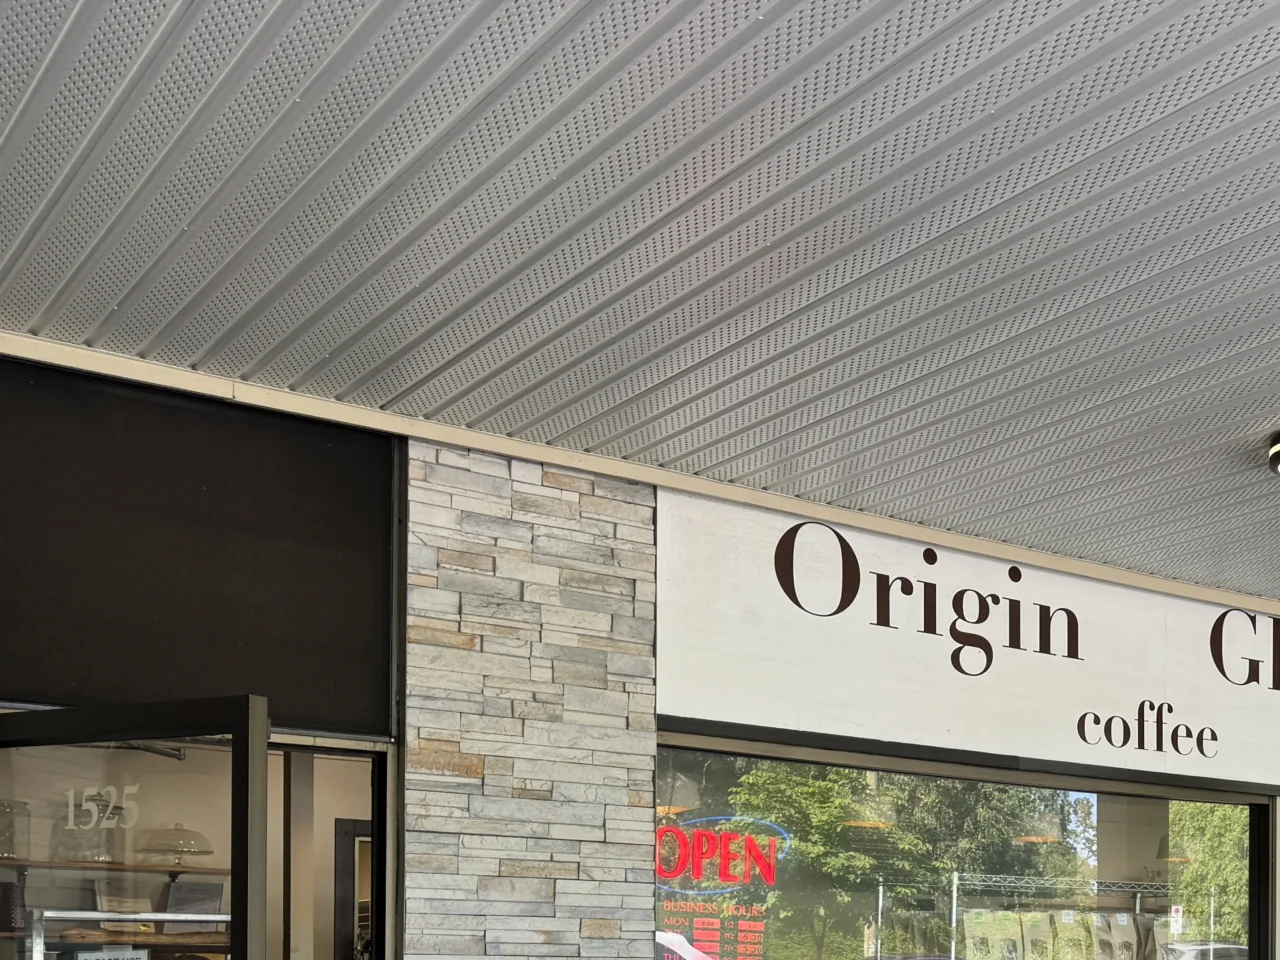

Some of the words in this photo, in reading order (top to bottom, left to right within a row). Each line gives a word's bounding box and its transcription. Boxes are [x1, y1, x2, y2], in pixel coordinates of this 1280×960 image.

[774, 521, 1084, 676] Origin
[1077, 700, 1219, 758] coffee
[64, 783, 140, 830] 1525
[656, 826, 776, 885] OPEN
[663, 900, 718, 914] BUSINESS
[724, 904, 766, 917] HOURS
[664, 917, 689, 926] MON
